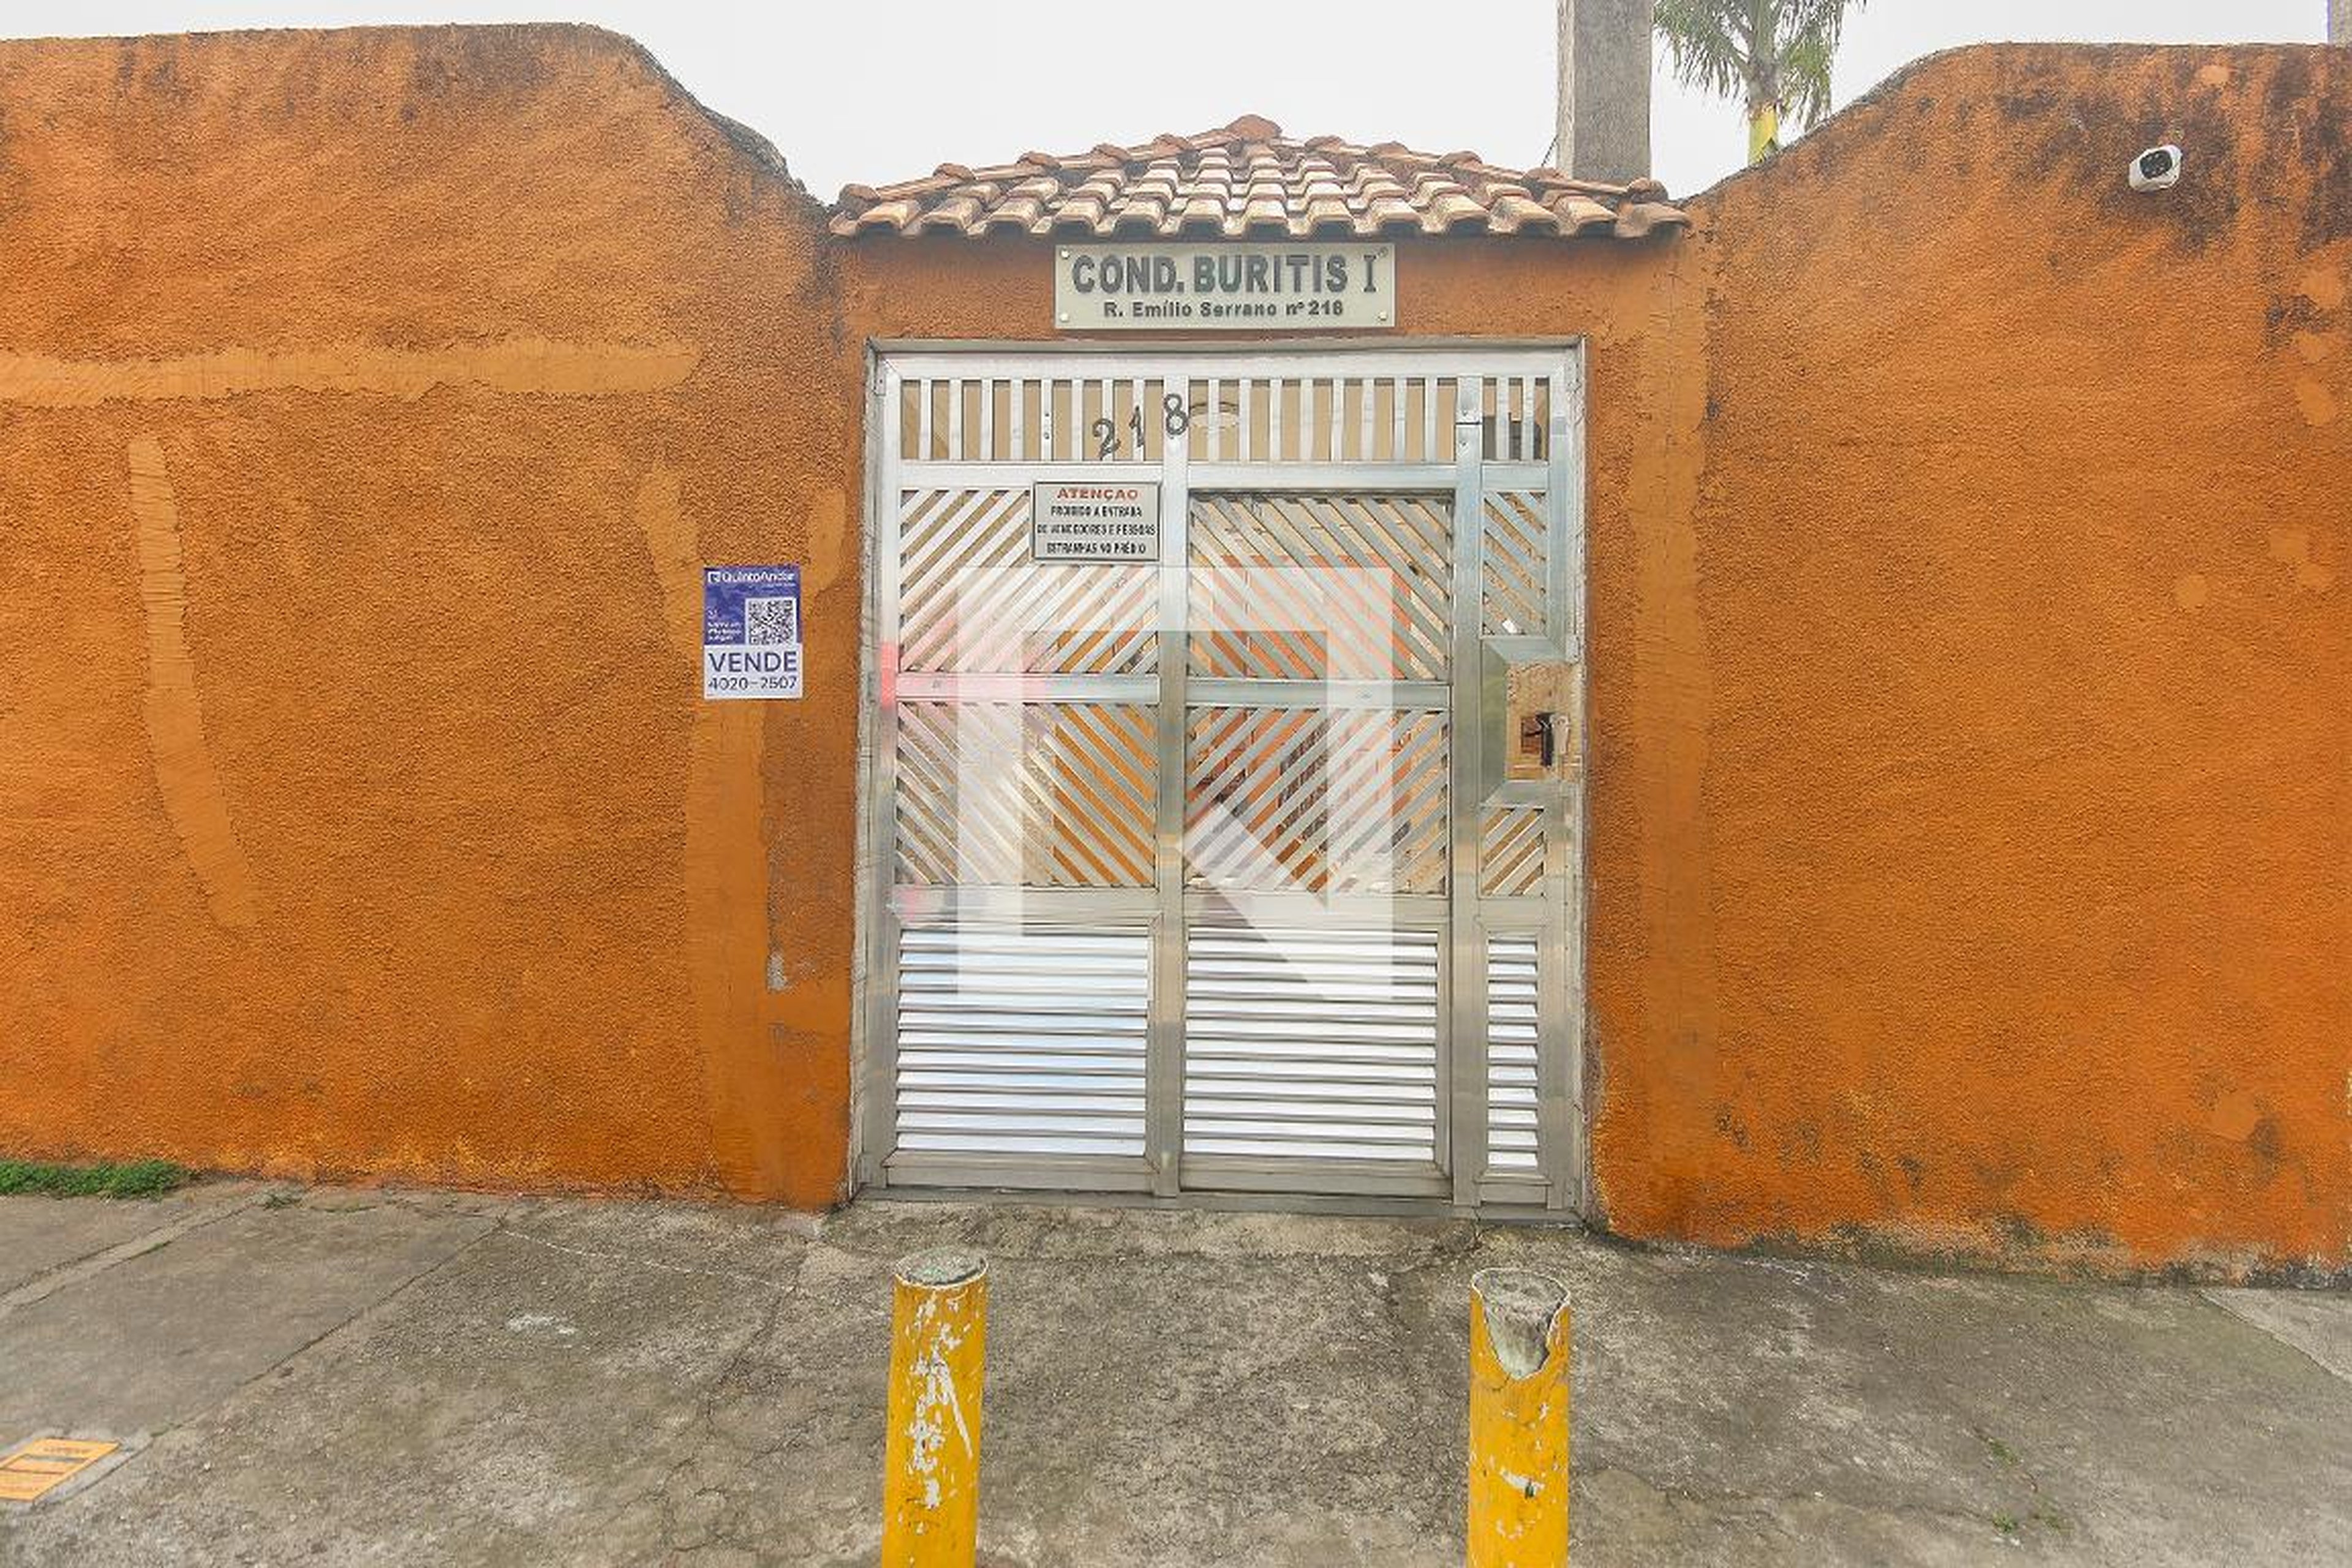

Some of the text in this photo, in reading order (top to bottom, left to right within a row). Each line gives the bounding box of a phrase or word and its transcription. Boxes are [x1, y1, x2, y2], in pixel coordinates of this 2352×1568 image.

[1072, 254, 1377, 293] COND. BURITIS I
[1104, 301, 1123, 317] R.
[1133, 300, 1193, 317] Emílio
[1200, 301, 1277, 317] Serrano
[1308, 300, 1343, 316] 218
[709, 652, 796, 673] VENDE
[709, 676, 796, 690] 4020-2507
